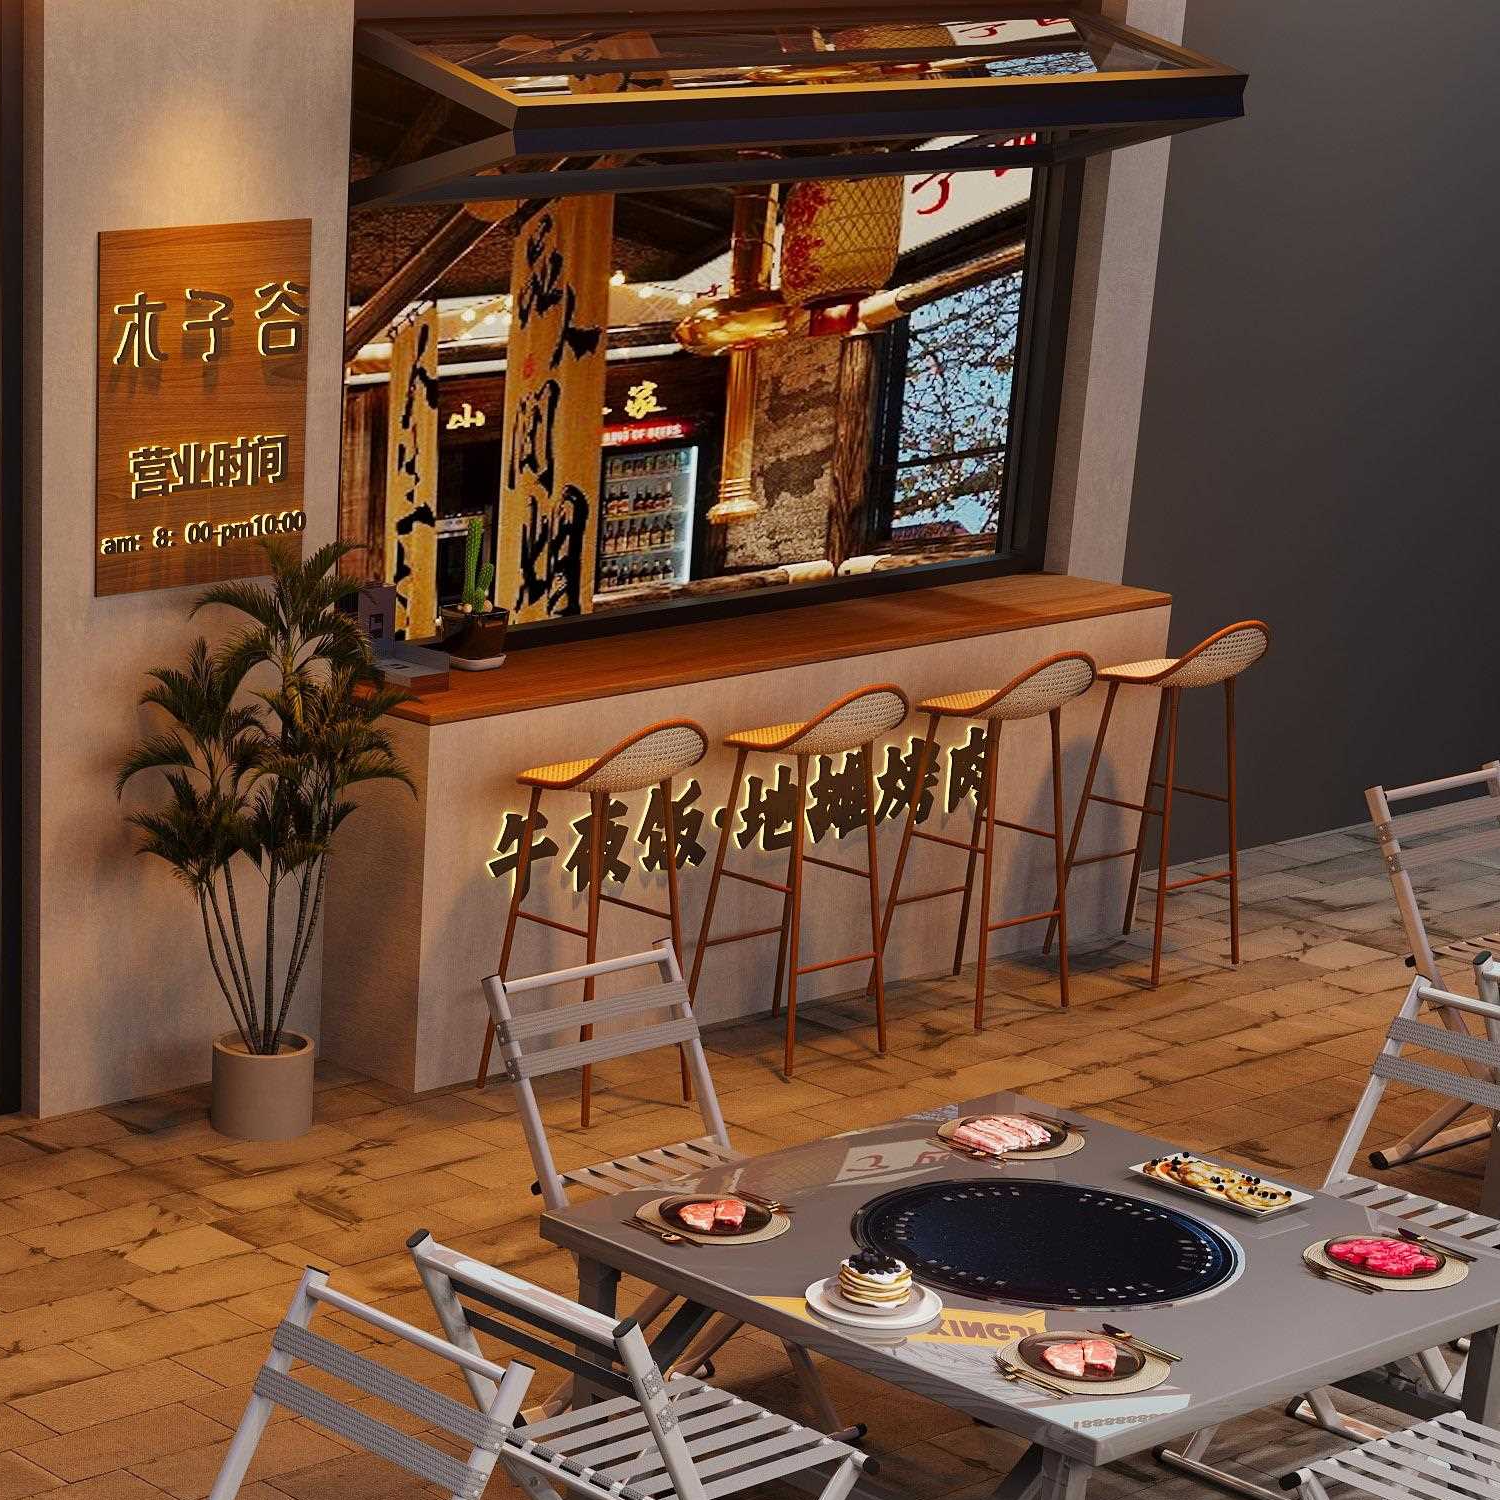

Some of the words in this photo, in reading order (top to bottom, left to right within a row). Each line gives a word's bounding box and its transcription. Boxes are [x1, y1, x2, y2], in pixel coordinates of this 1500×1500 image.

[113, 281, 309, 367] 木子谷
[129, 434, 288, 499] 营业时间
